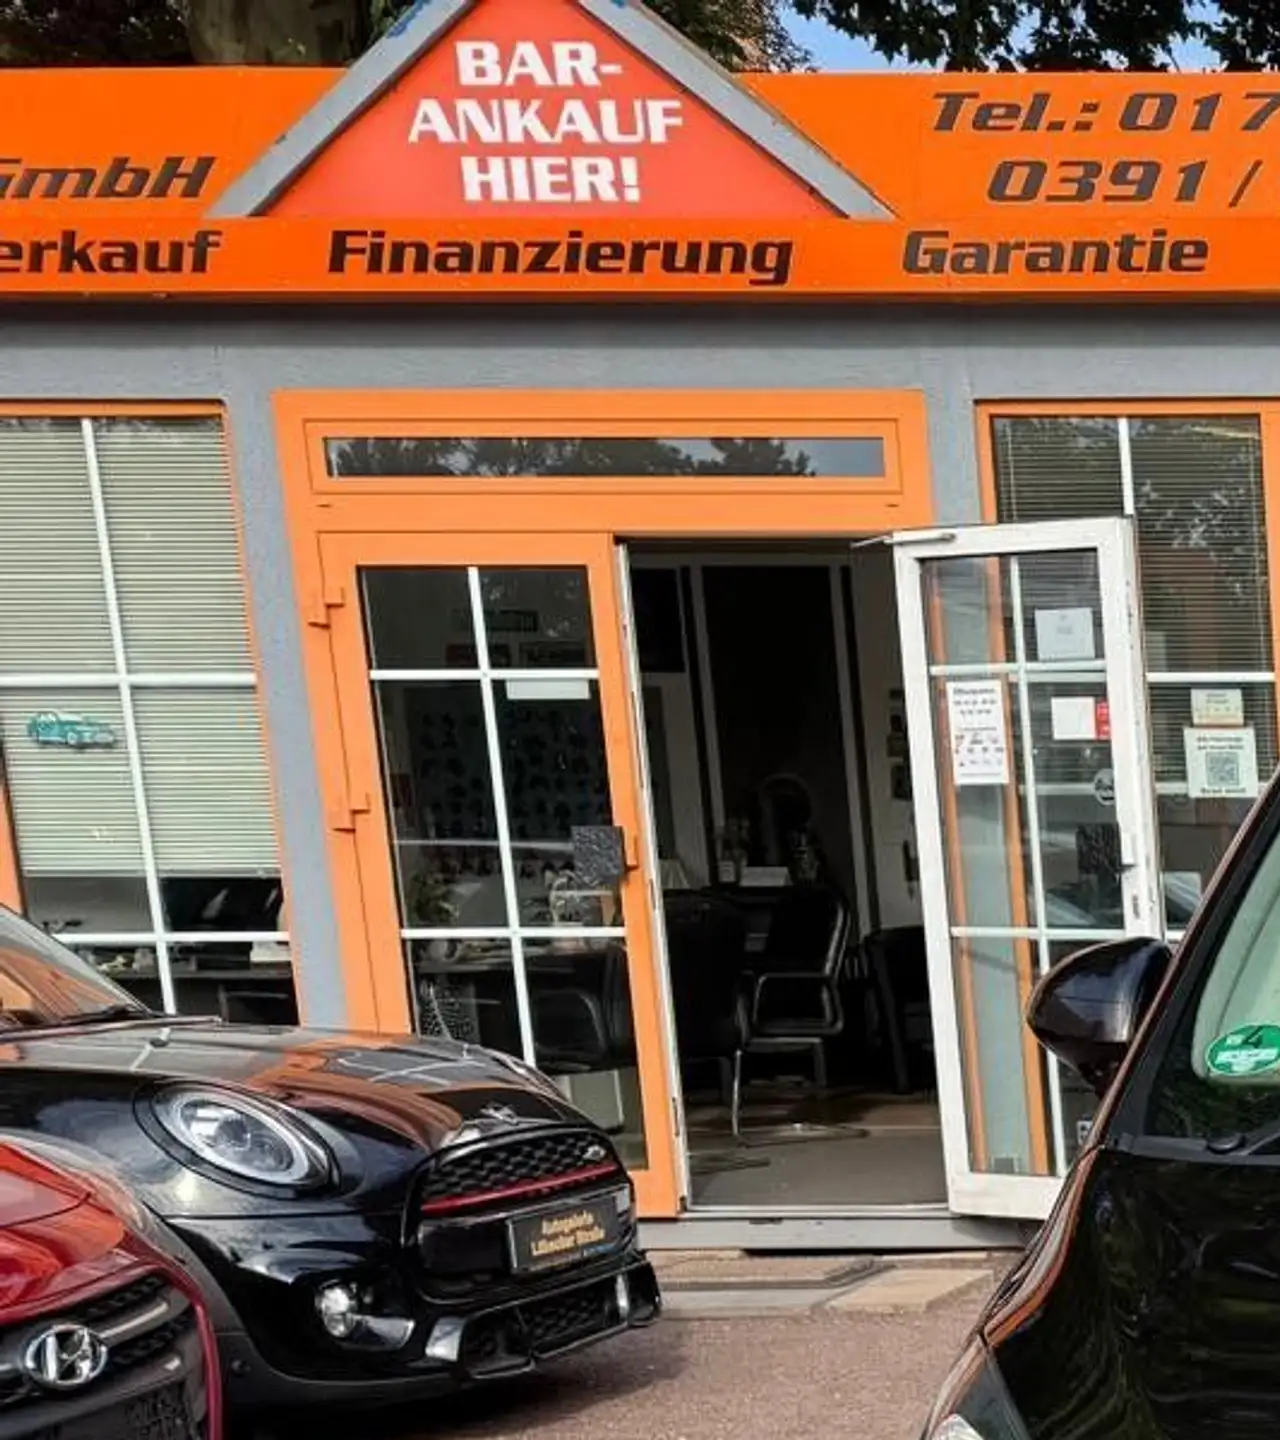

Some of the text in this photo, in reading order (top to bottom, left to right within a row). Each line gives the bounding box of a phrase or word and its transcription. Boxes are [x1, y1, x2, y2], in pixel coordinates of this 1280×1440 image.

[457, 40, 623, 87] BAR-
[408, 98, 683, 144] ANKAUF
[934, 92, 1097, 133] Tel.:
[461, 156, 641, 202] HIER!
[988, 160, 1206, 203] 0391
[1229, 161, 1261, 207] /
[328, 230, 793, 287] Finanzierung
[902, 229, 1209, 275] Garantie
